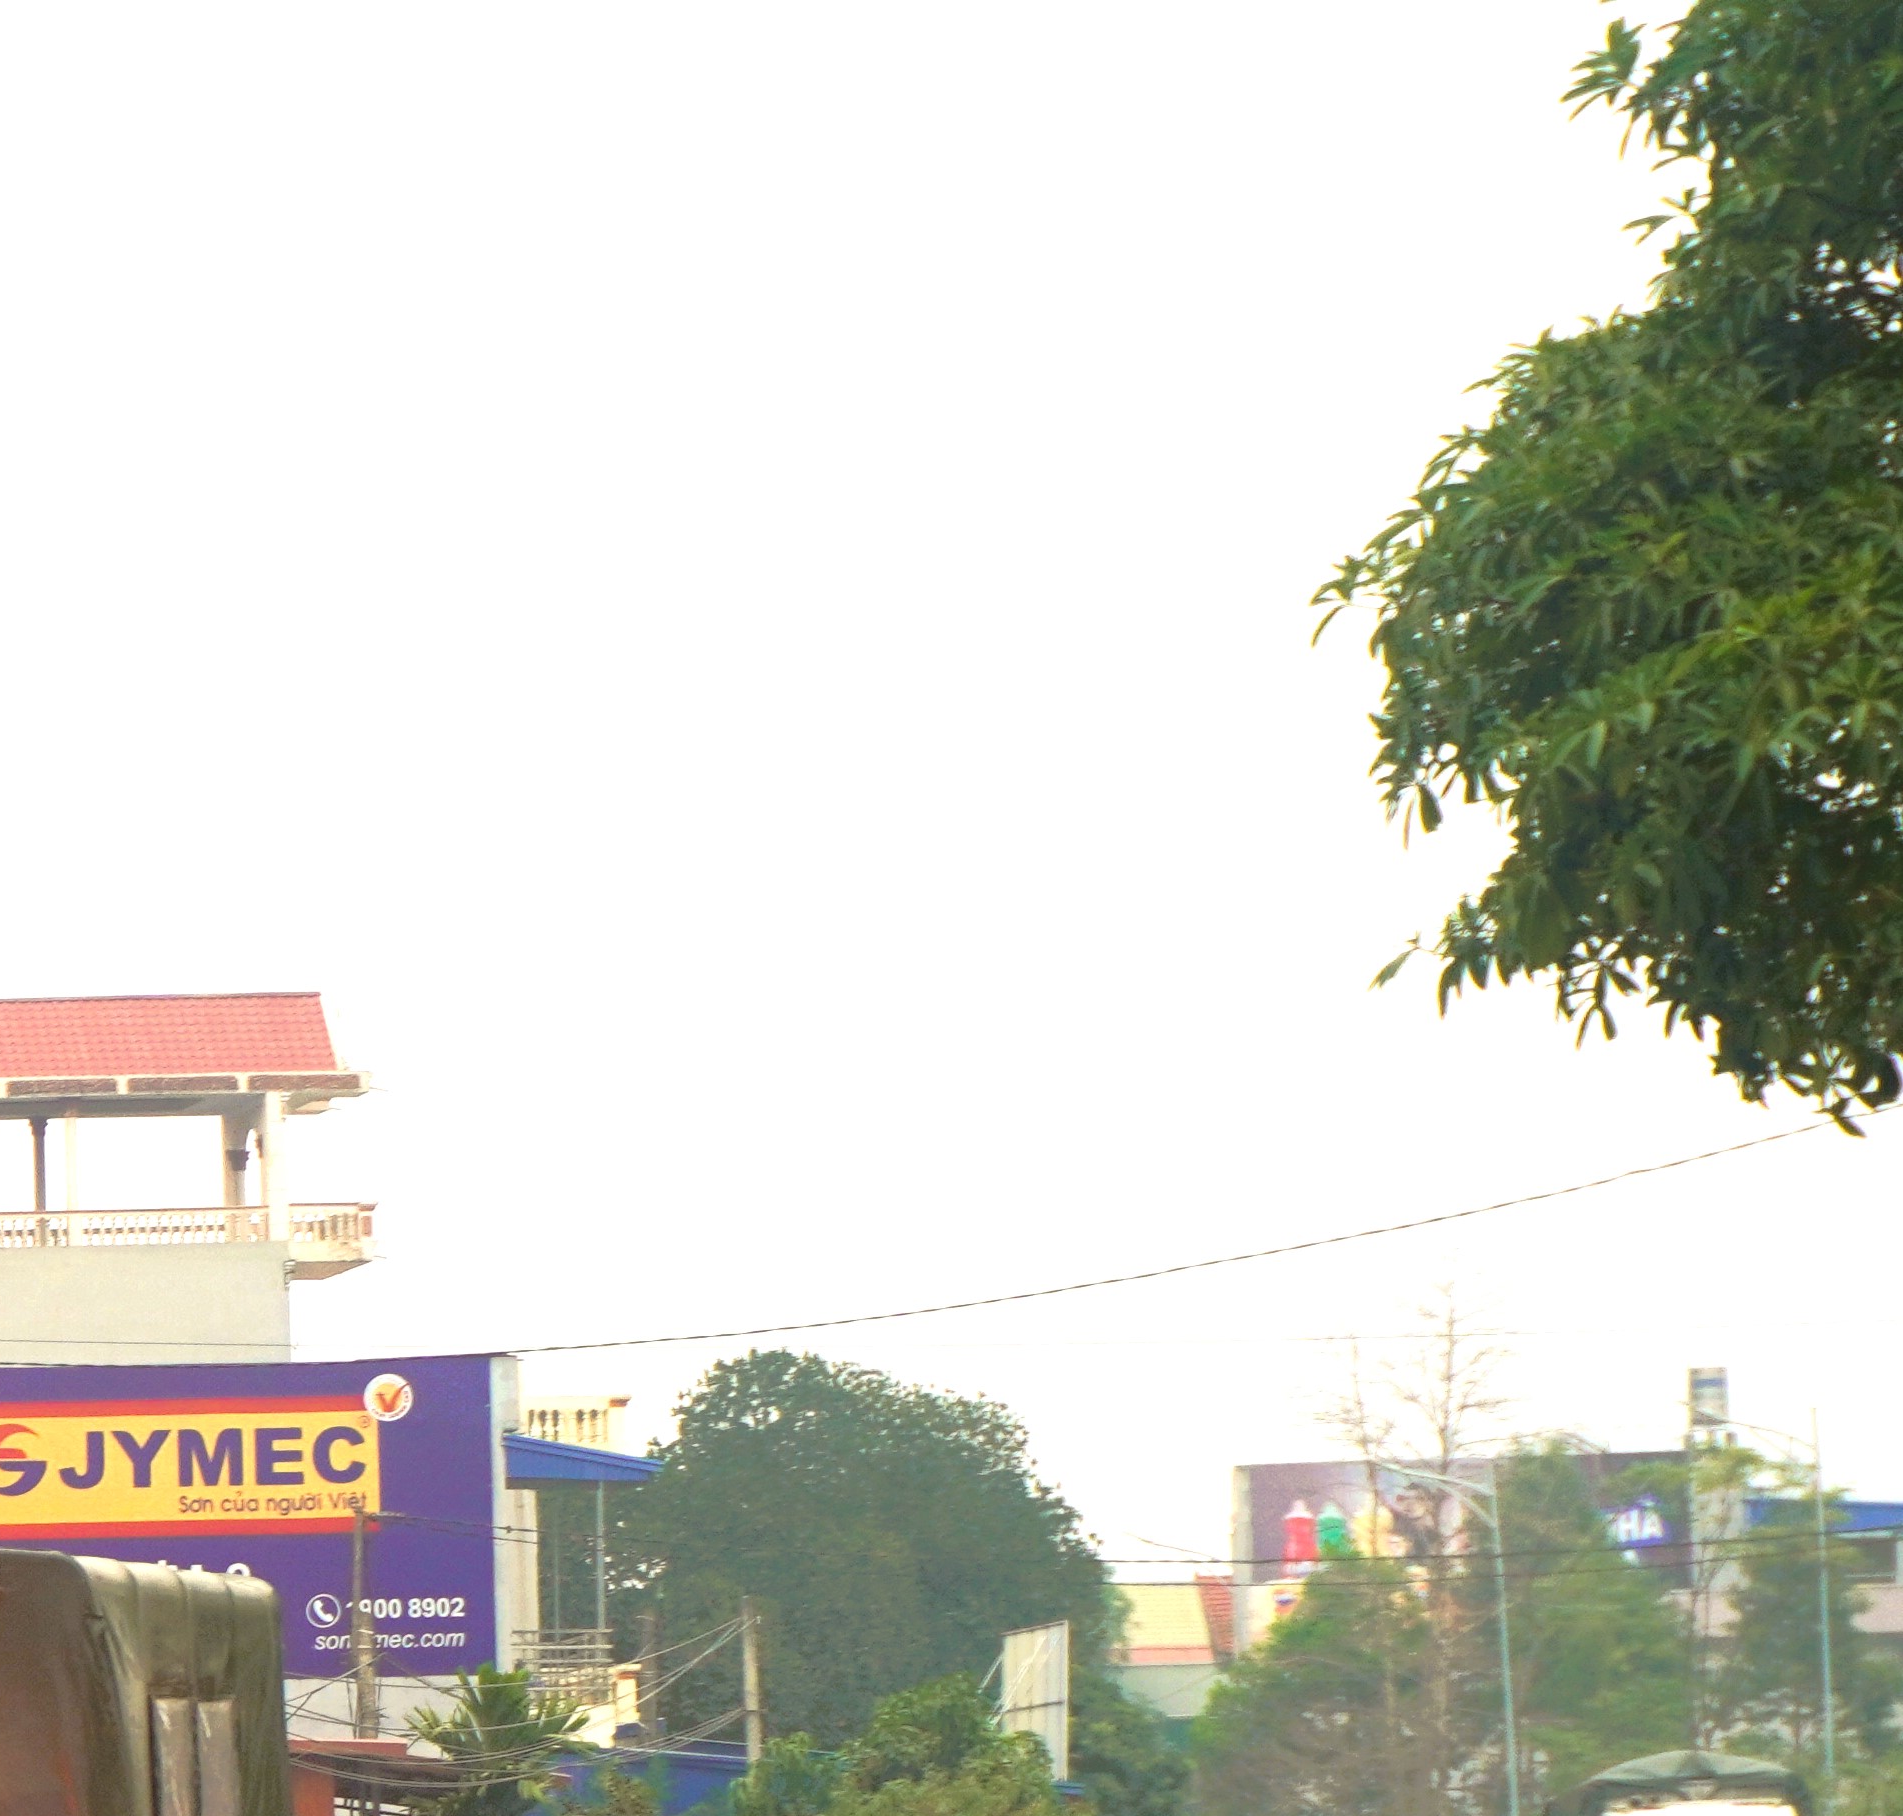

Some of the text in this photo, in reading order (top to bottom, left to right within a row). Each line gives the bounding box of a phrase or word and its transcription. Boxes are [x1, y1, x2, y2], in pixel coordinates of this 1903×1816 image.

[59, 1425, 366, 1489] JYMEC
[408, 1598, 465, 1618] 8902
[314, 1631, 465, 1650] sonmec.com
